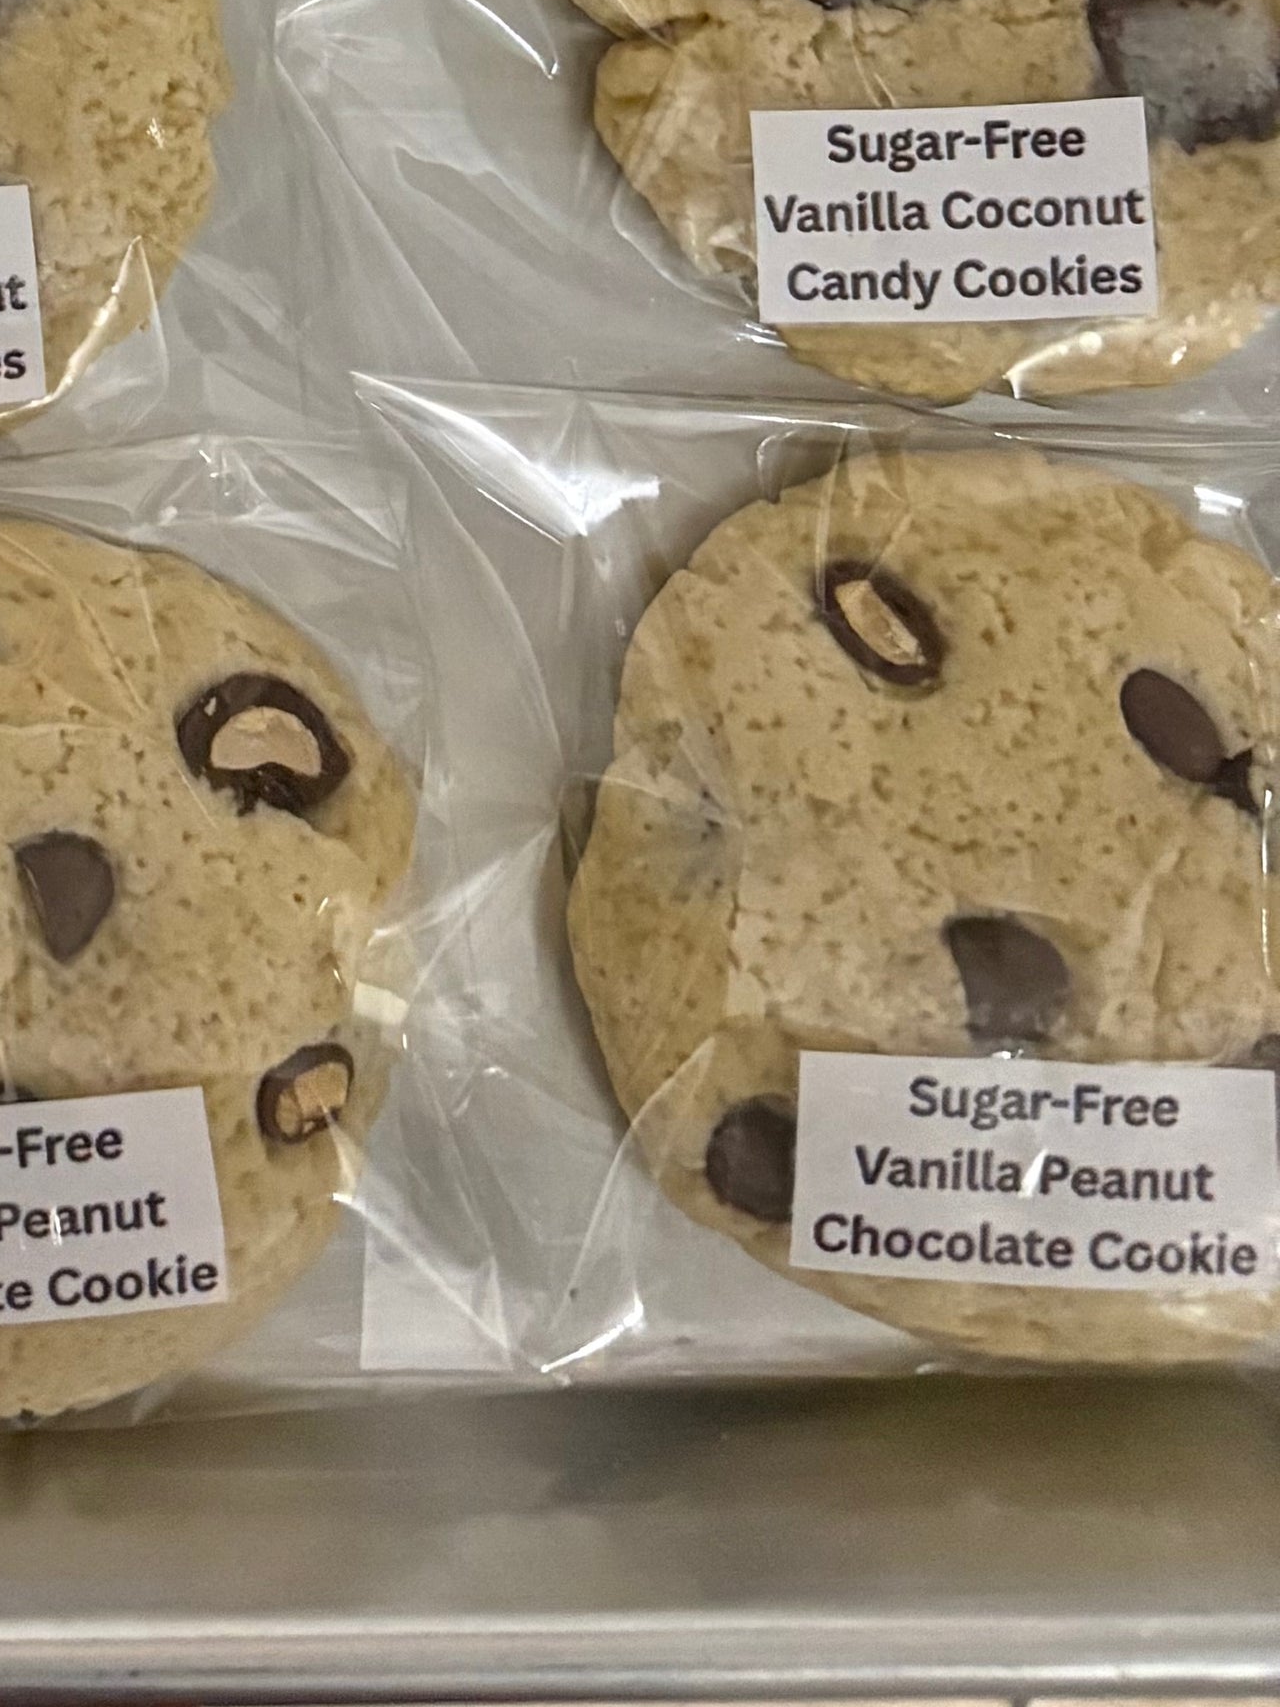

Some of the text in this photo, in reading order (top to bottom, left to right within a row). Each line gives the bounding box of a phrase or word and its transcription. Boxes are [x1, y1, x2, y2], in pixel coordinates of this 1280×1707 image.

[827, 119, 1087, 173] Sugar-Free
[763, 188, 1146, 234] Vanilla Coconut
[787, 253, 1143, 311] Candy Cookies
[908, 1075, 1180, 1132] Sugar-Free
[854, 1144, 1214, 1202] Vanilla Peanut
[812, 1212, 1258, 1276] Chocolate Cookie
[47, 1254, 219, 1307] Cookie
